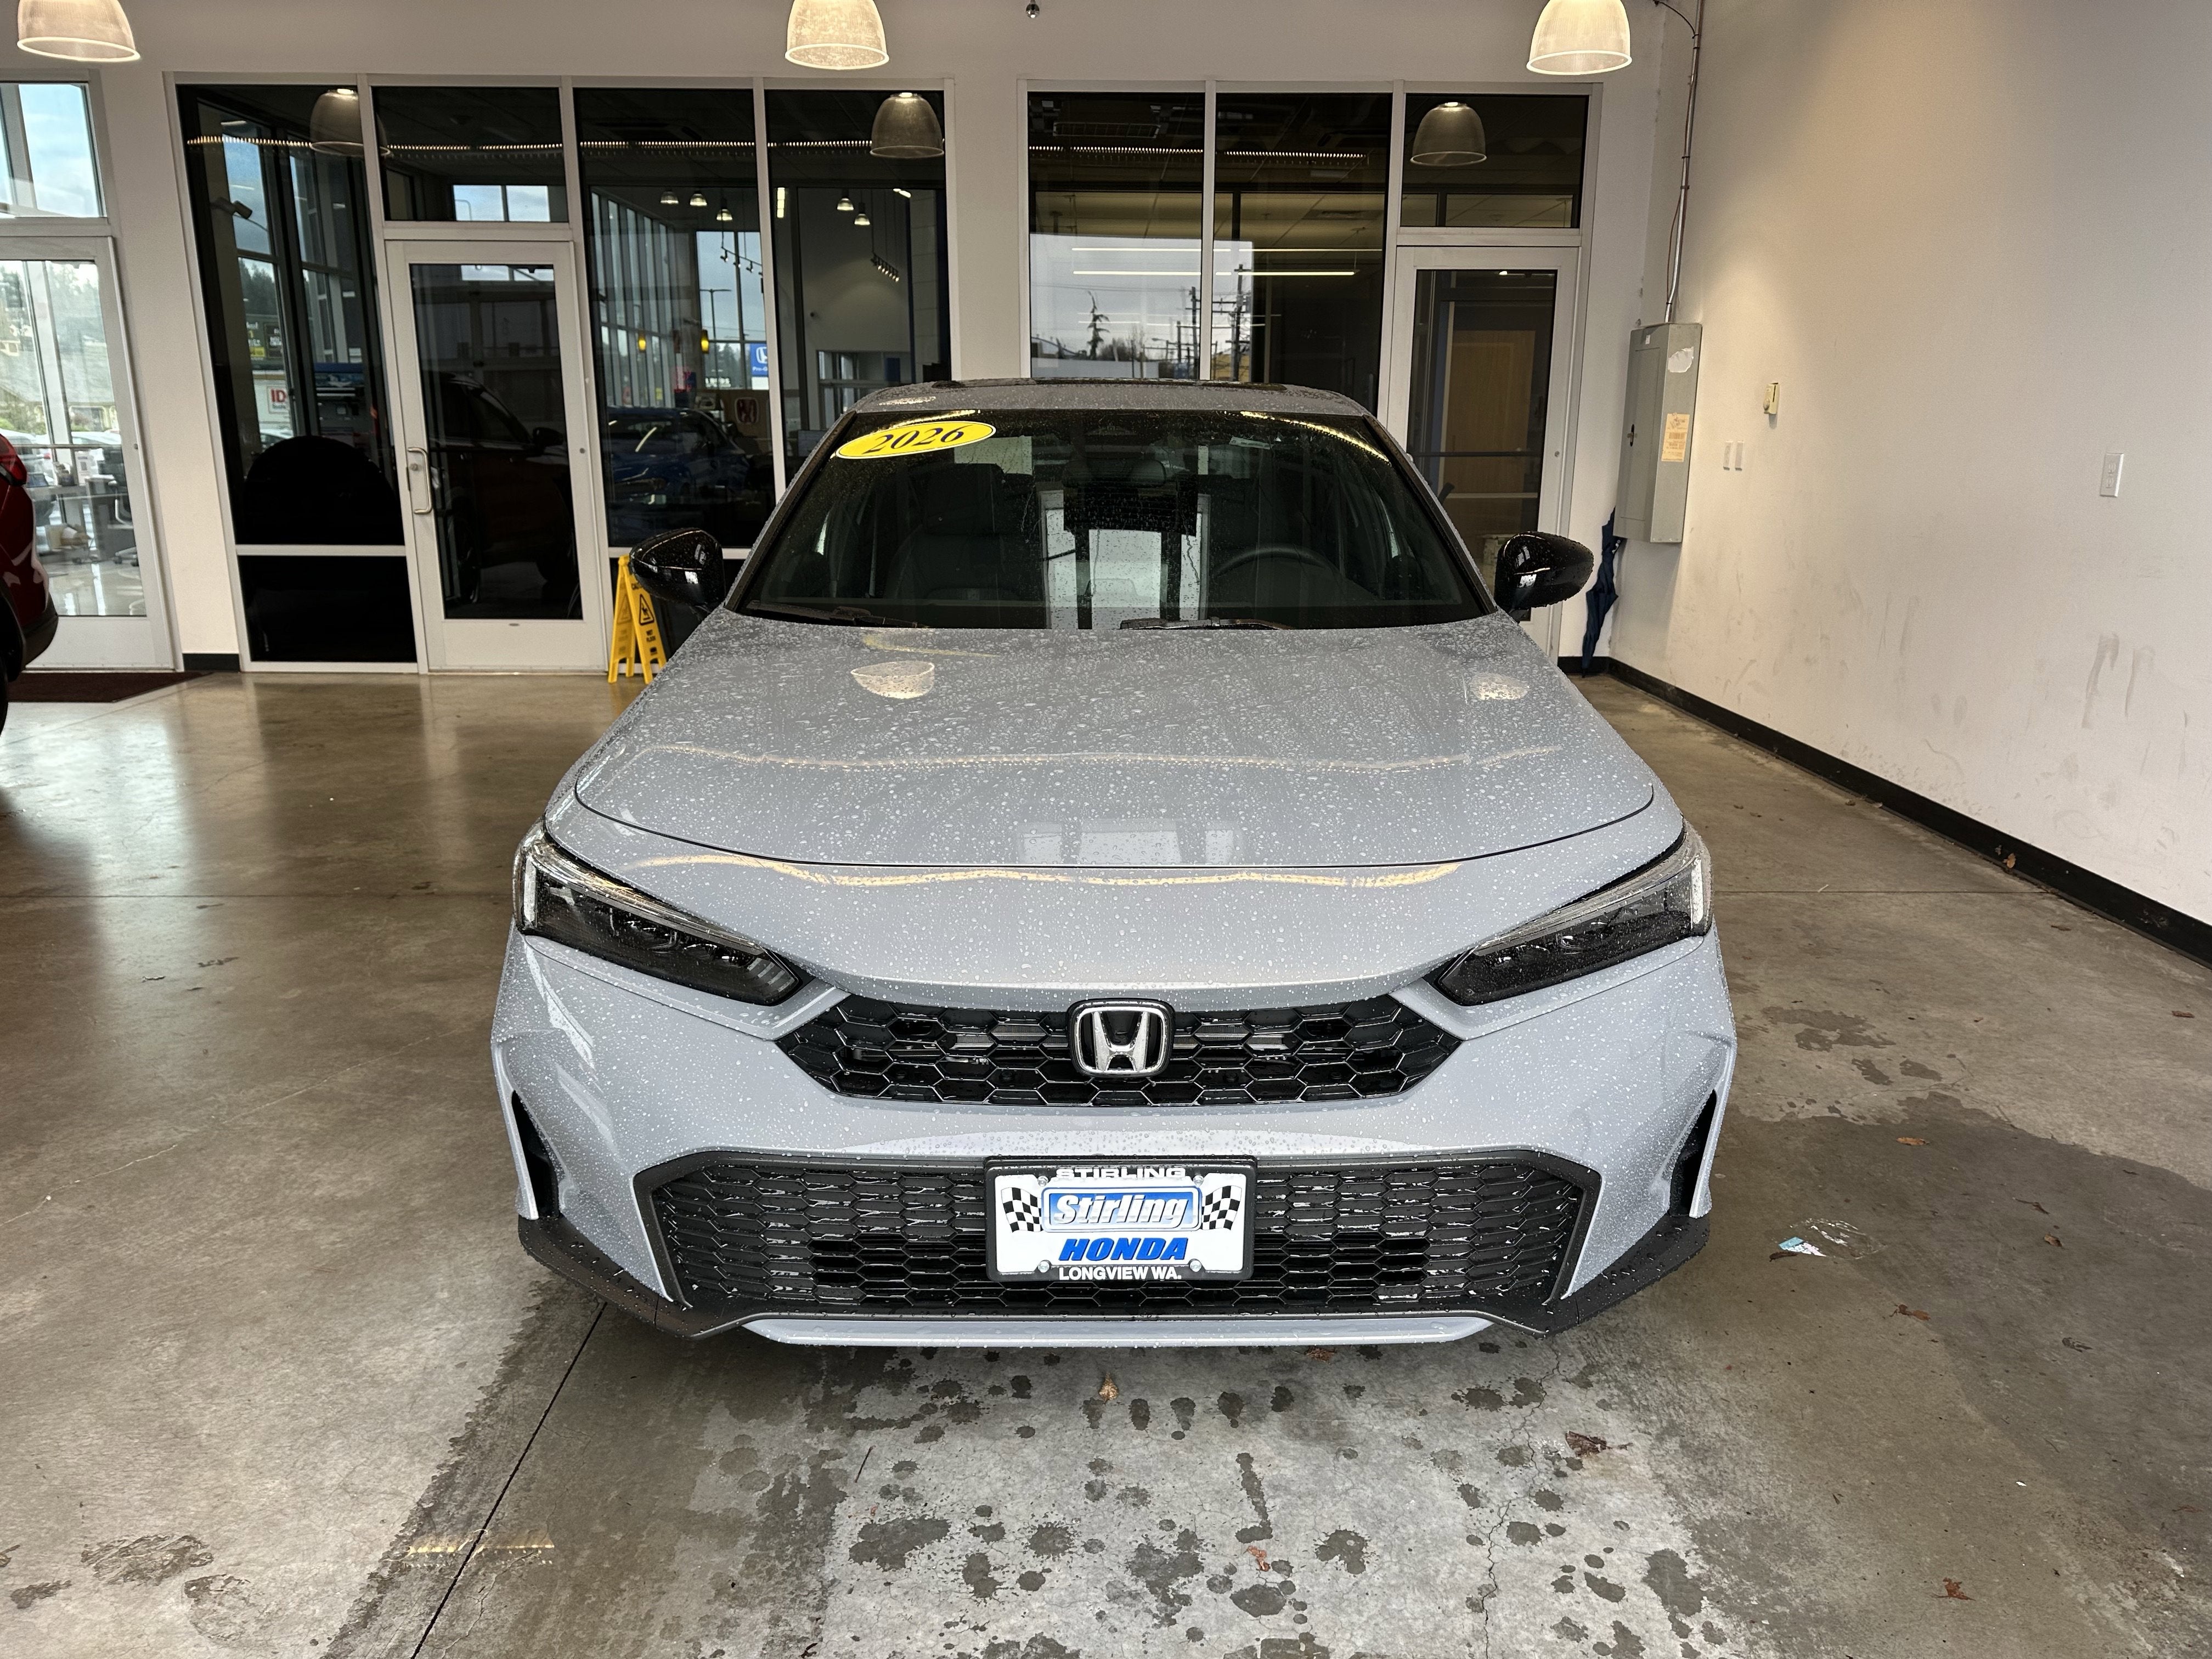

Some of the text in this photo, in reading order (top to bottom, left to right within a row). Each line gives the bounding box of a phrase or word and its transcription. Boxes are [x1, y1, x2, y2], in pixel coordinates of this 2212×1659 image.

[861, 425, 972, 454] 2026
[1056, 1167, 1186, 1178] STIRLING
[1053, 1194, 1189, 1228] Stirling
[1058, 1238, 1189, 1261] HONDA
[1058, 1266, 1182, 1280] LONGVIEW WA.
